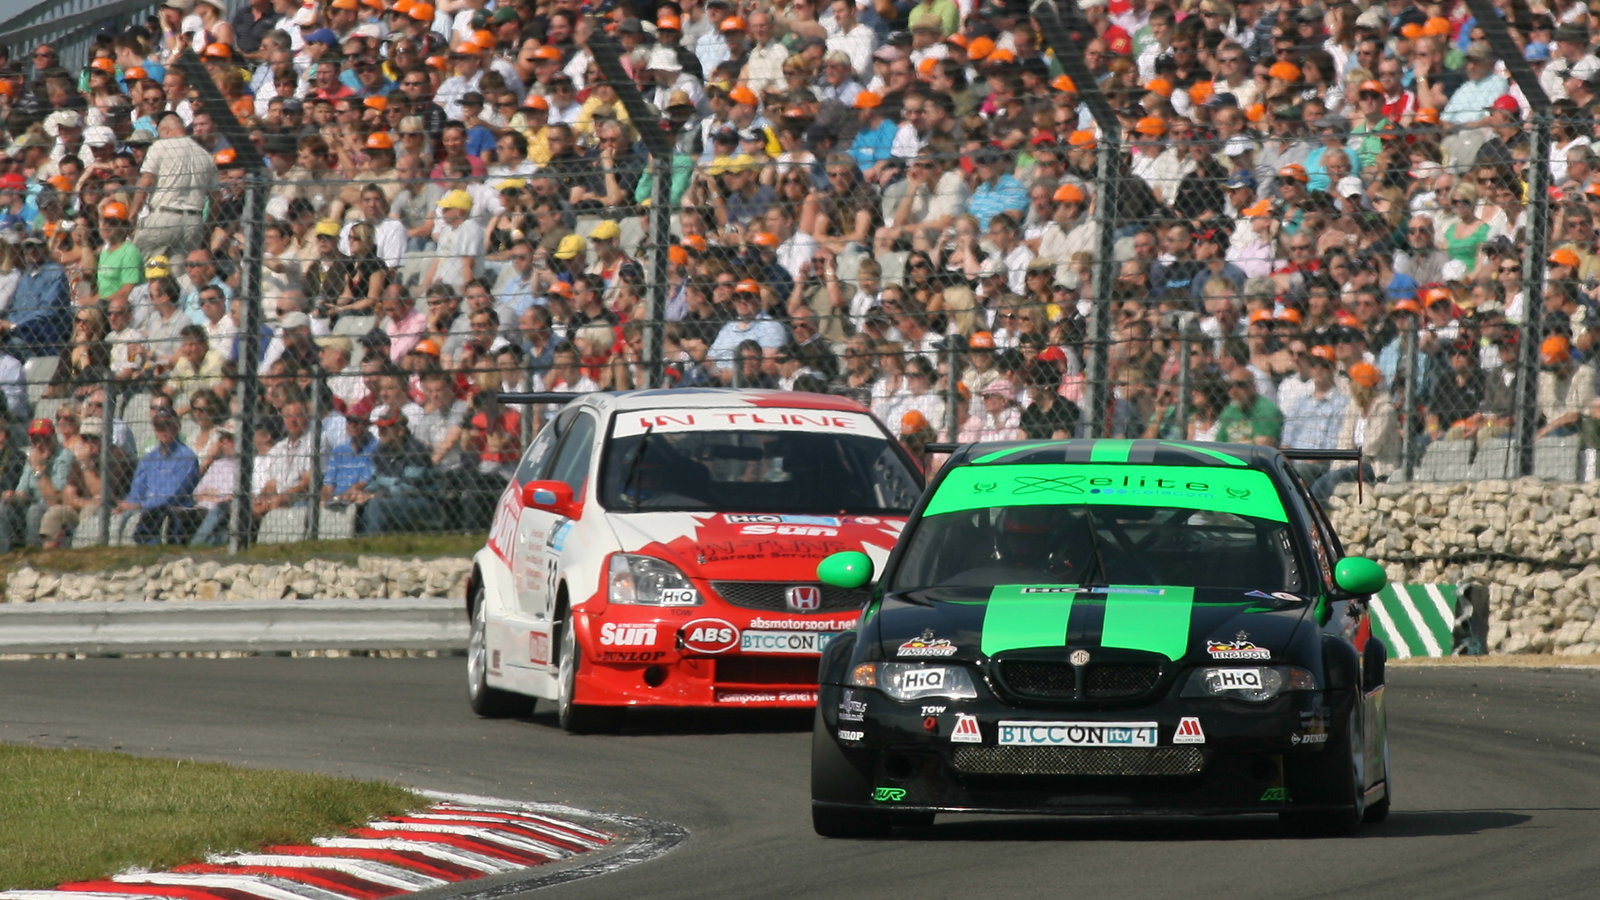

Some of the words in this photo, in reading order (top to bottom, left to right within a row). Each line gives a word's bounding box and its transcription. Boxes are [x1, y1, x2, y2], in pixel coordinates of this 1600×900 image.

[707, 413, 857, 429] TUNE
[1089, 475, 1209, 492] elite
[1132, 489, 1214, 499] telecom
[740, 525, 839, 537] Sun
[708, 552, 765, 562] Garage
[663, 591, 693, 602] HiQ
[749, 616, 857, 631] absmotorsport.net
[600, 622, 657, 646] Sun
[689, 627, 732, 643] ABS
[602, 651, 666, 662] DUNLOP
[905, 672, 942, 688] HiQ
[1221, 672, 1259, 687] HiQ
